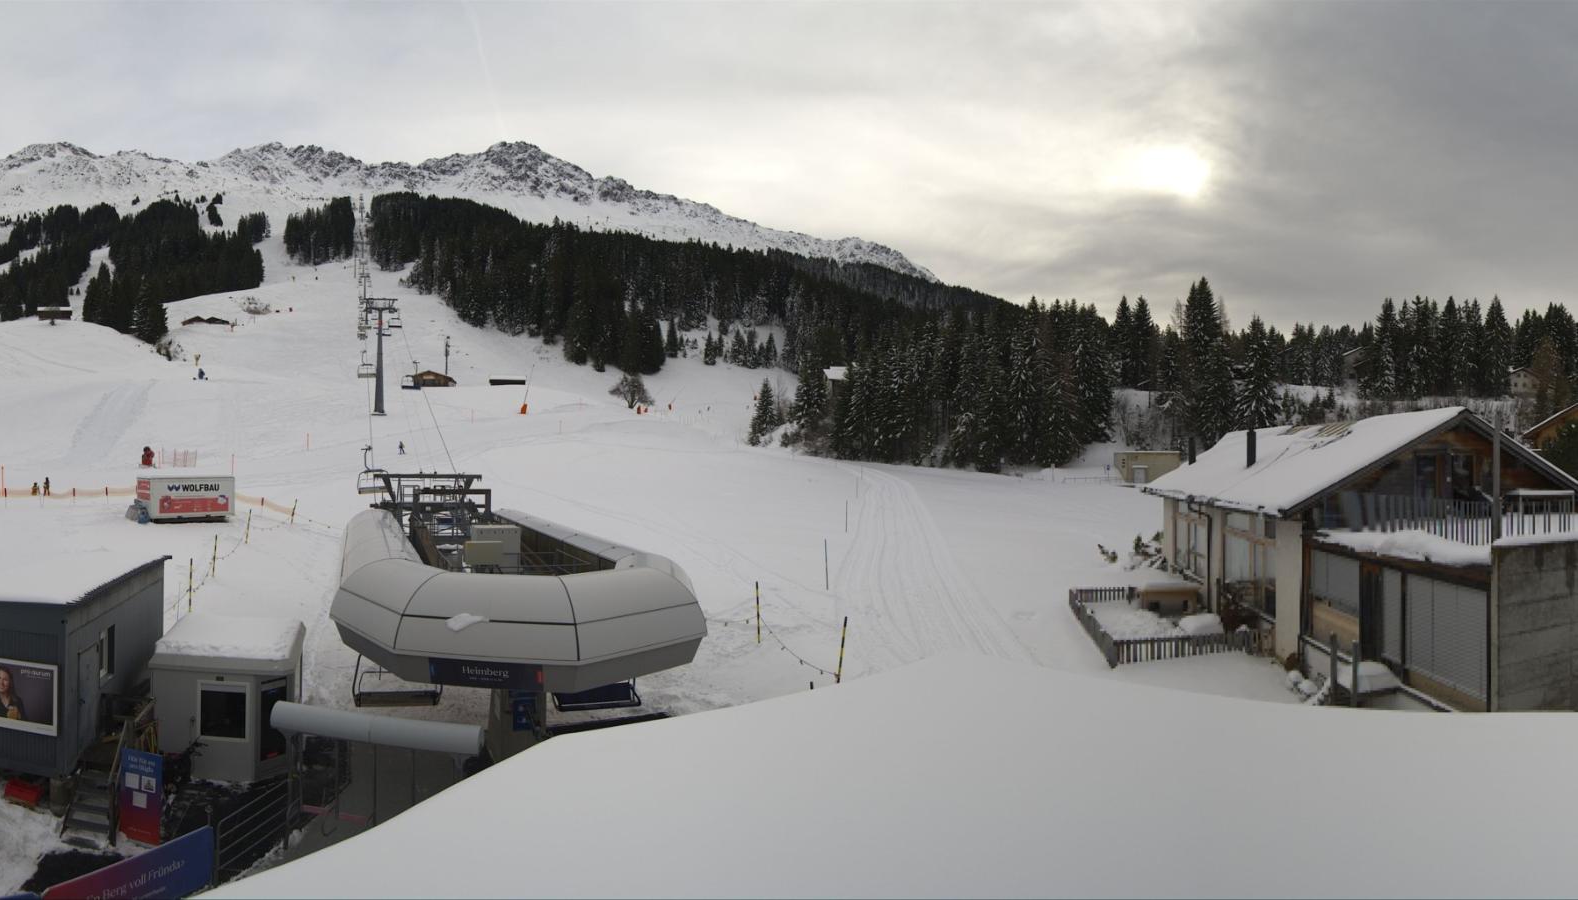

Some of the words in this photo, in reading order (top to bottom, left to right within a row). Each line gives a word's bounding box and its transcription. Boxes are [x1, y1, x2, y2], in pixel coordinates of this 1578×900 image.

[181, 483, 220, 492] WOLFBAU
[462, 665, 509, 678] Heimberg
[102, 884, 127, 900] Berg
[129, 872, 147, 889] voll
